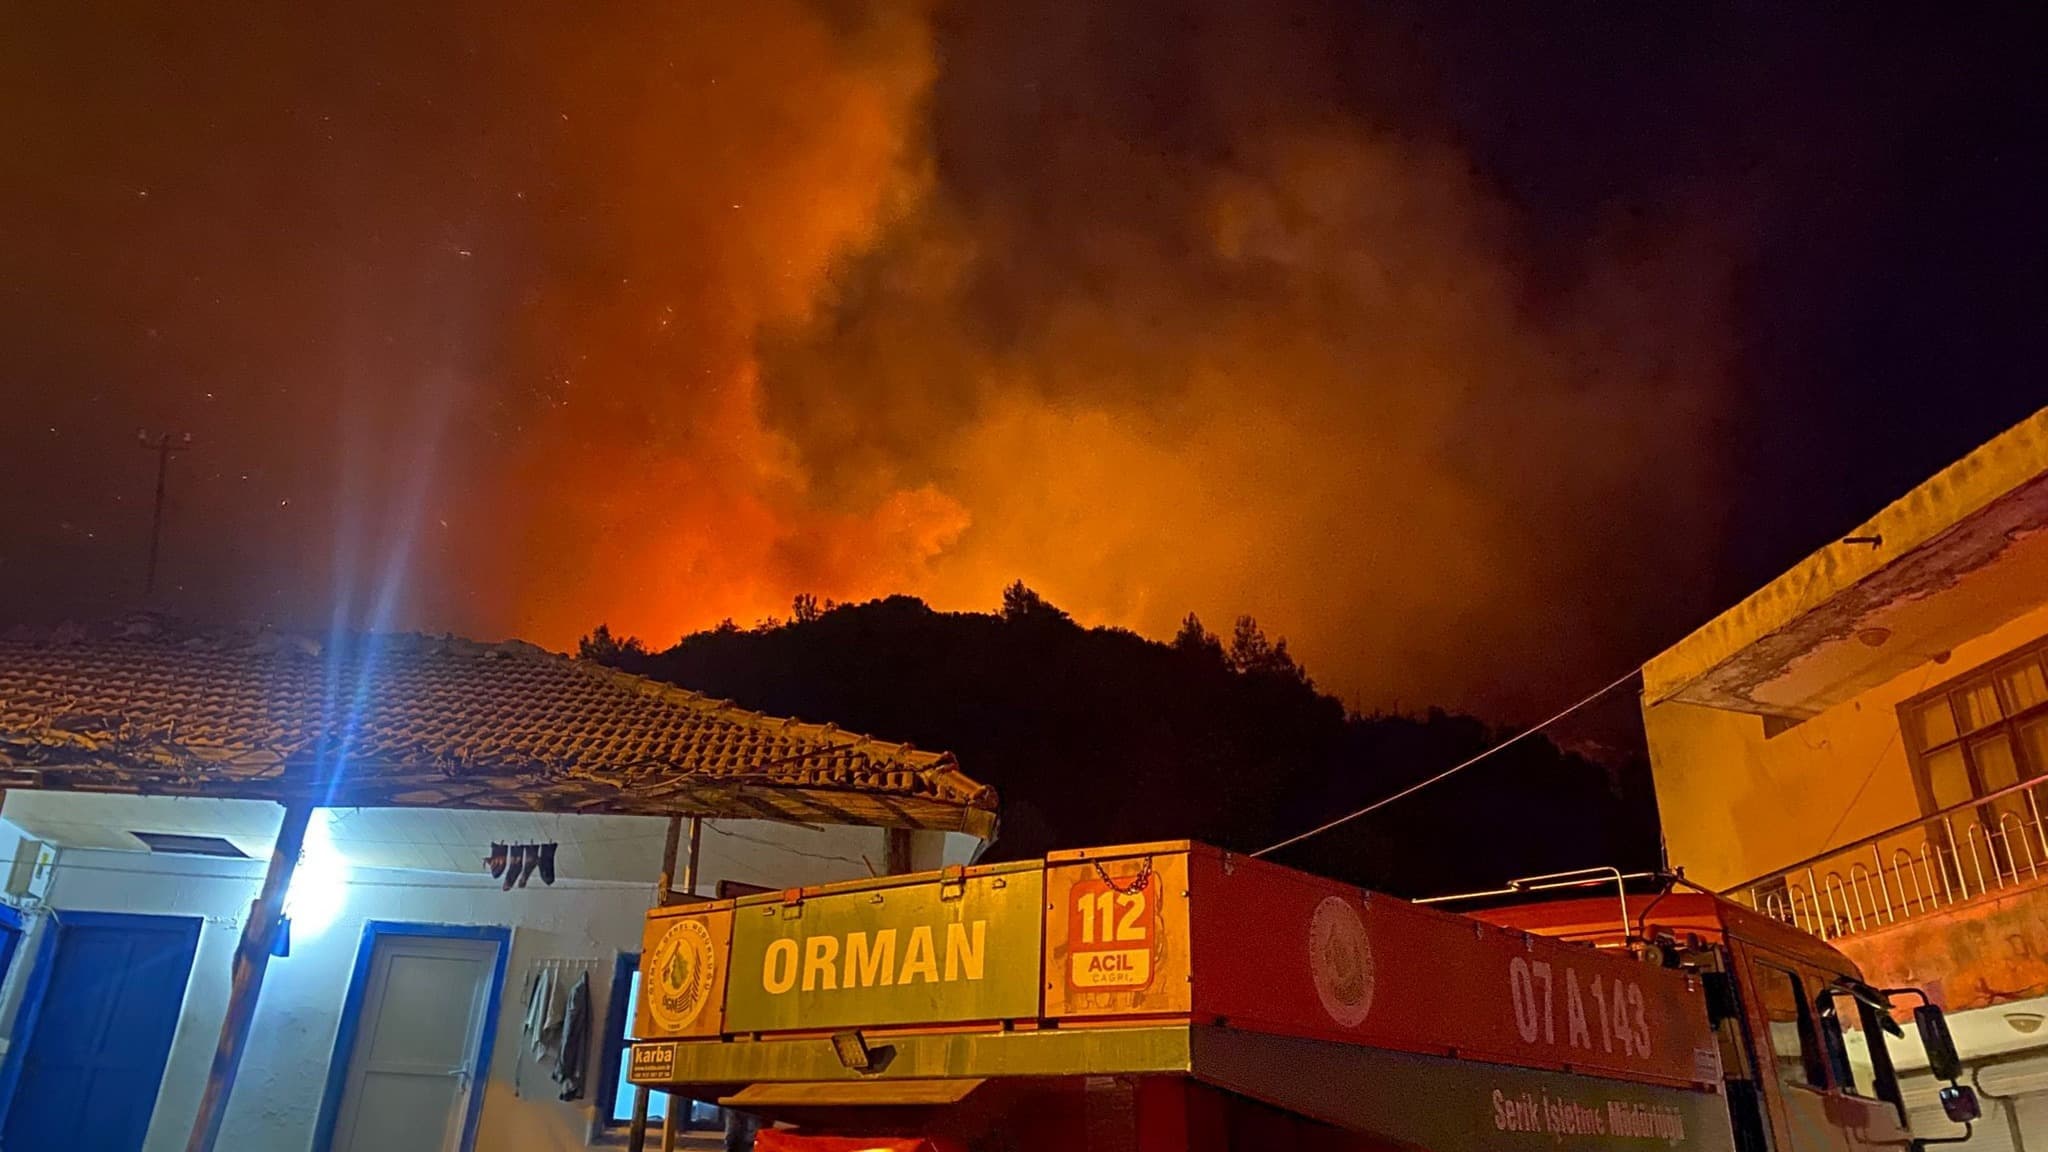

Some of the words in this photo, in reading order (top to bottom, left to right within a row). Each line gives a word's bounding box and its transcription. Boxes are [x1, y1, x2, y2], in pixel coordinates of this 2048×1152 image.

[1078, 890, 1146, 944] 112
[763, 920, 986, 994] ORMAN
[1509, 956, 1554, 1044] 07
[1566, 967, 1592, 1050] A
[1591, 974, 1651, 1060] 143
[635, 1046, 672, 1064] karba
[1493, 1089, 1541, 1132] Serik
